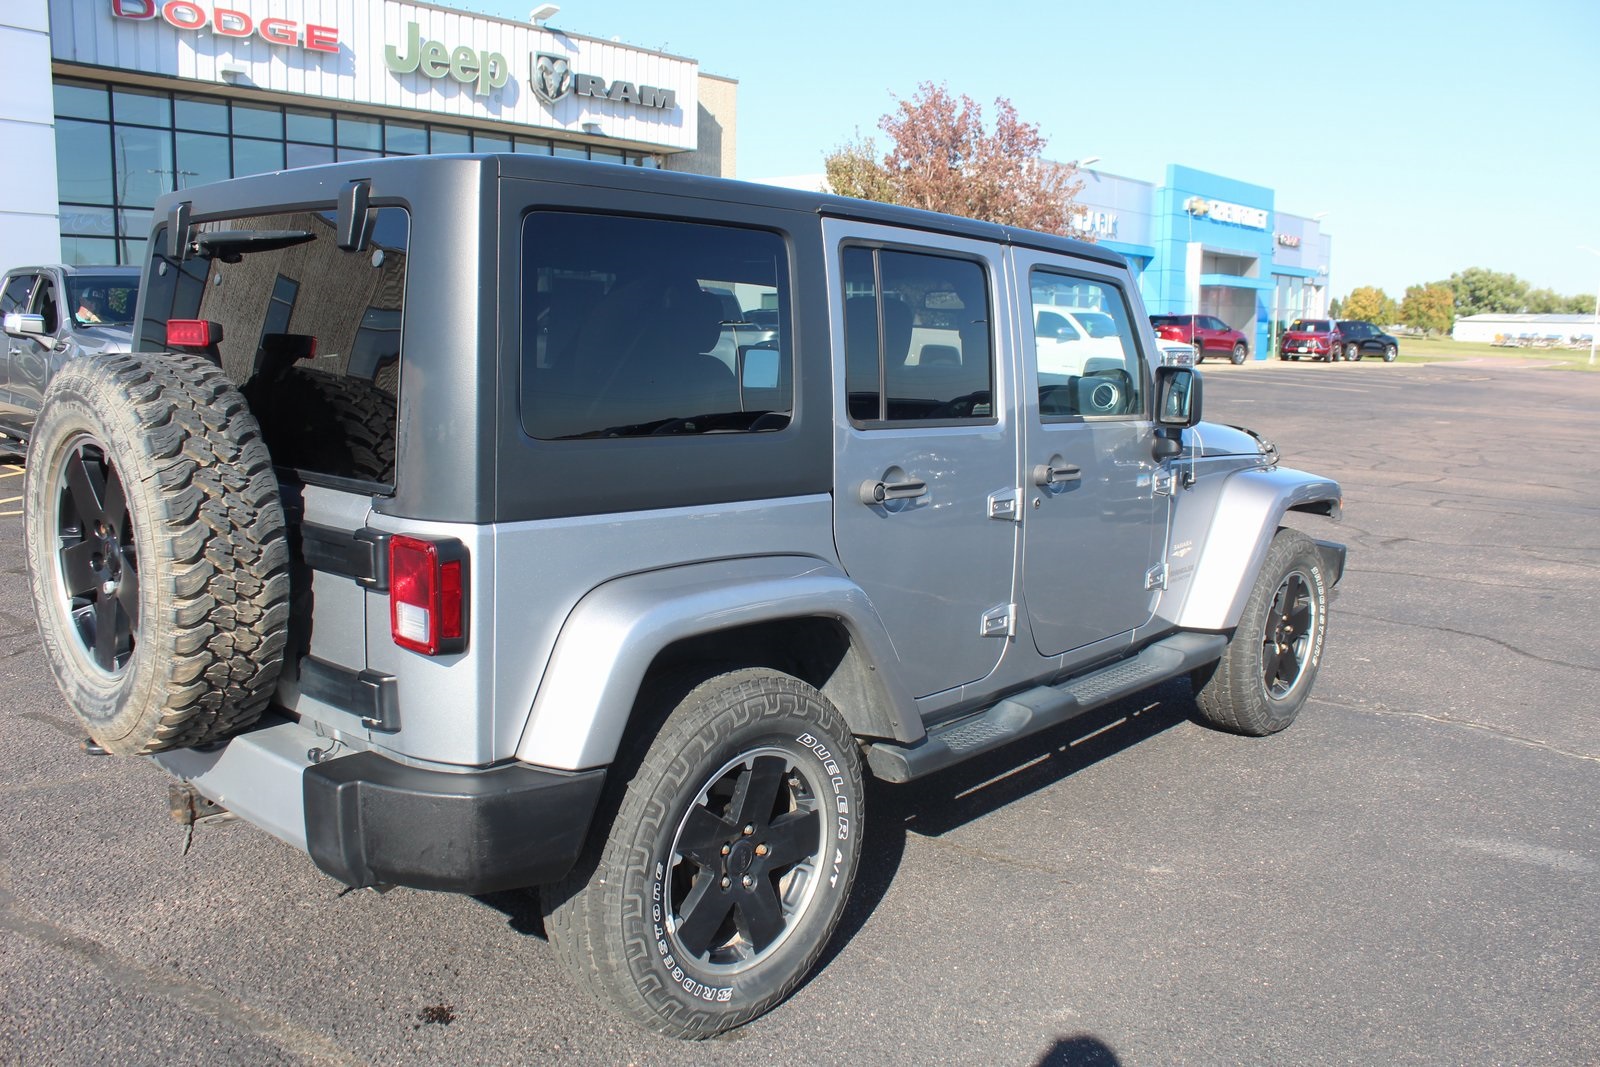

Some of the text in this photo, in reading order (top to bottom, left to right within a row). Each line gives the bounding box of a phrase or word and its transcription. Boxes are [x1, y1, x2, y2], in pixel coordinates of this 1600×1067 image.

[112, 0, 340, 54] DODGE
[384, 21, 509, 97] Jeep
[574, 72, 677, 110] RAM
[796, 731, 850, 890] DUELER A/T
[651, 861, 735, 1003] BRIDGESTONE
